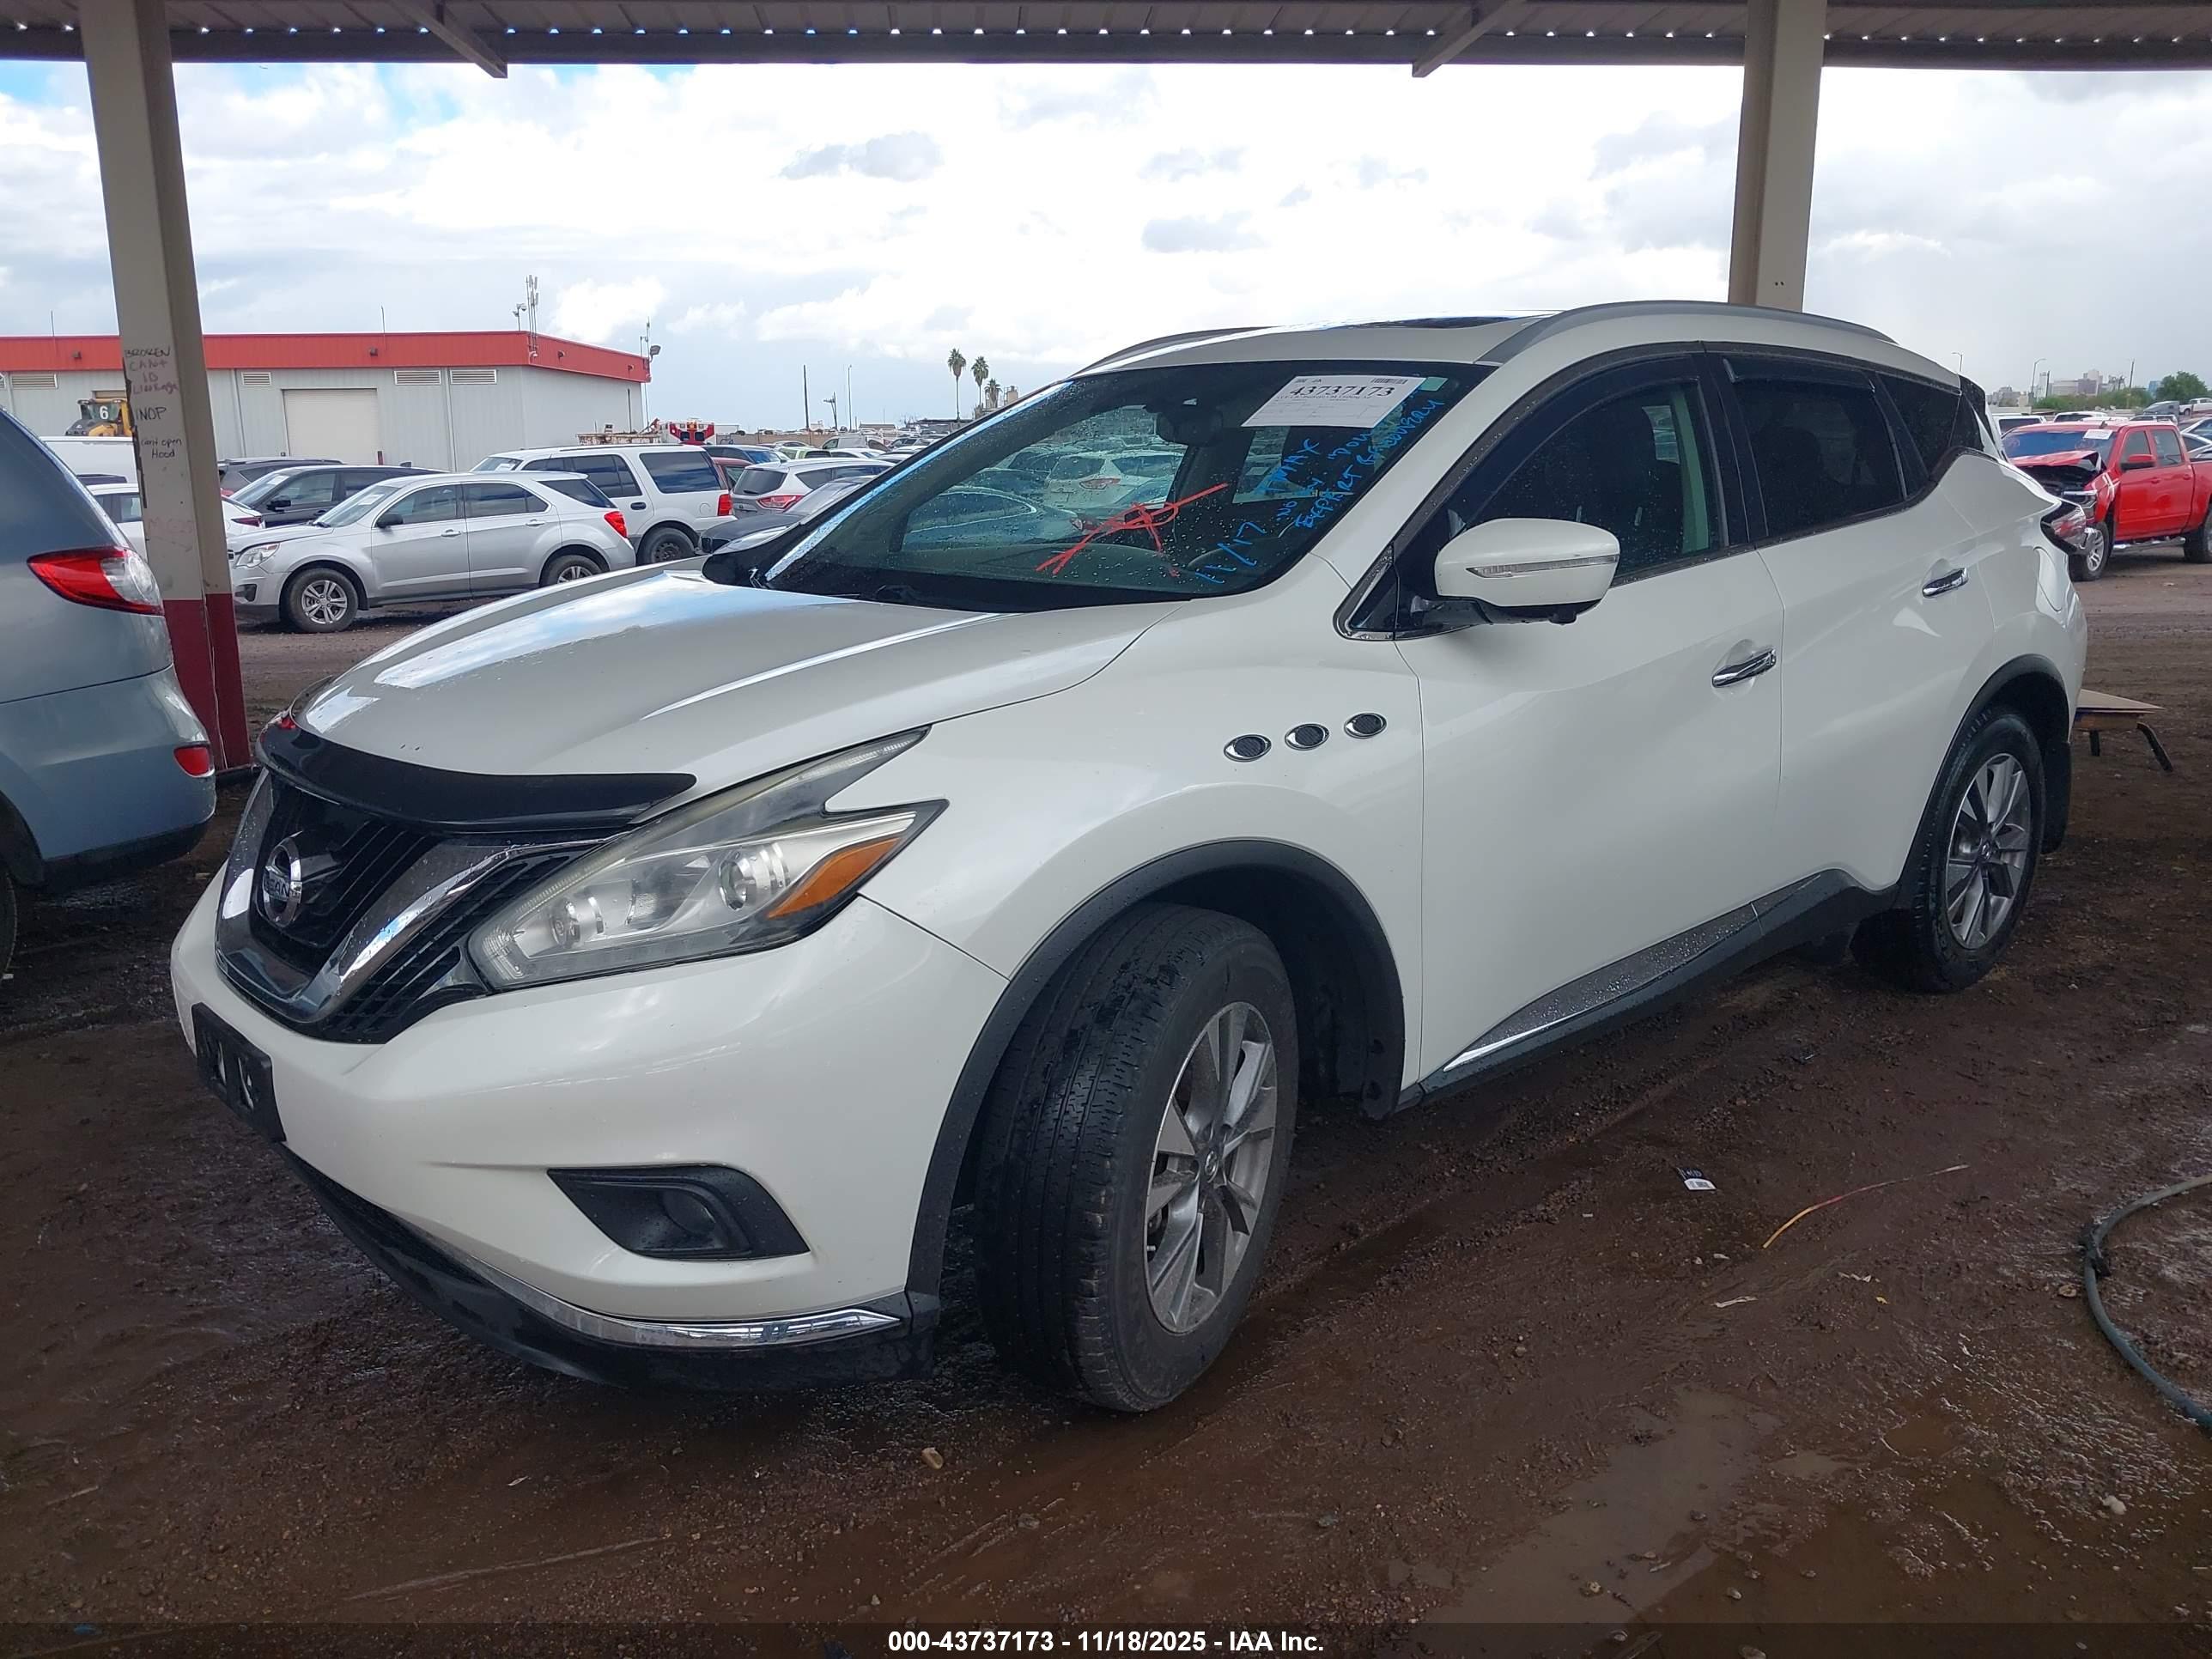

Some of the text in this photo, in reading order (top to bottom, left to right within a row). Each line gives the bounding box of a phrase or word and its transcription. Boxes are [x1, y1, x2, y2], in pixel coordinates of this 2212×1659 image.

[1290, 385, 1395, 398] 43737173
[99, 405, 109, 420] 6
[136, 407, 167, 421] INOP
[152, 448, 176, 459] Hood
